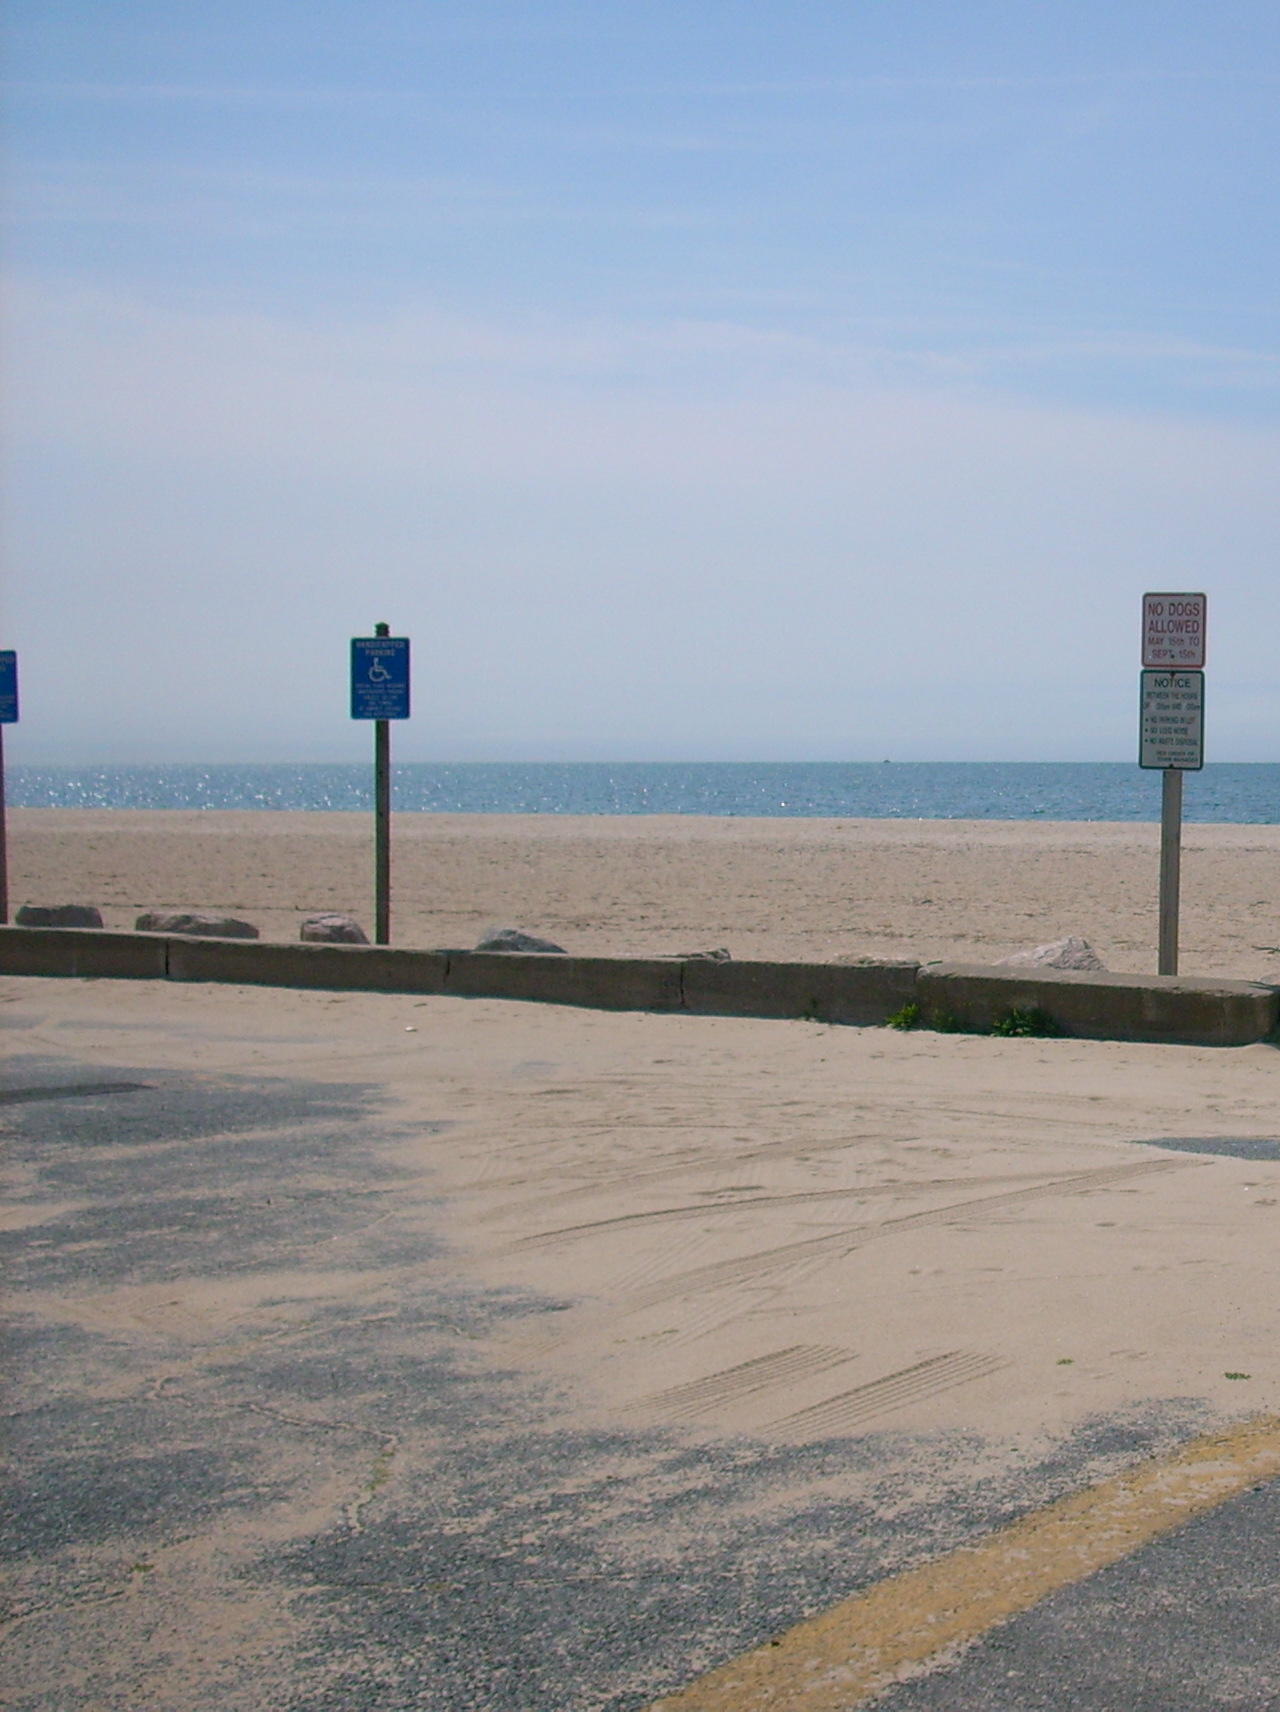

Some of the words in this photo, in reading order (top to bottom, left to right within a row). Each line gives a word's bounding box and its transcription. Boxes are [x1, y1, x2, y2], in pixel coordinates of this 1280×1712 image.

[1148, 602, 1164, 617] NO
[1169, 602, 1200, 617] DOGS
[1148, 619, 1200, 634] ALLOWED
[1154, 678, 1191, 688] NOTICE
